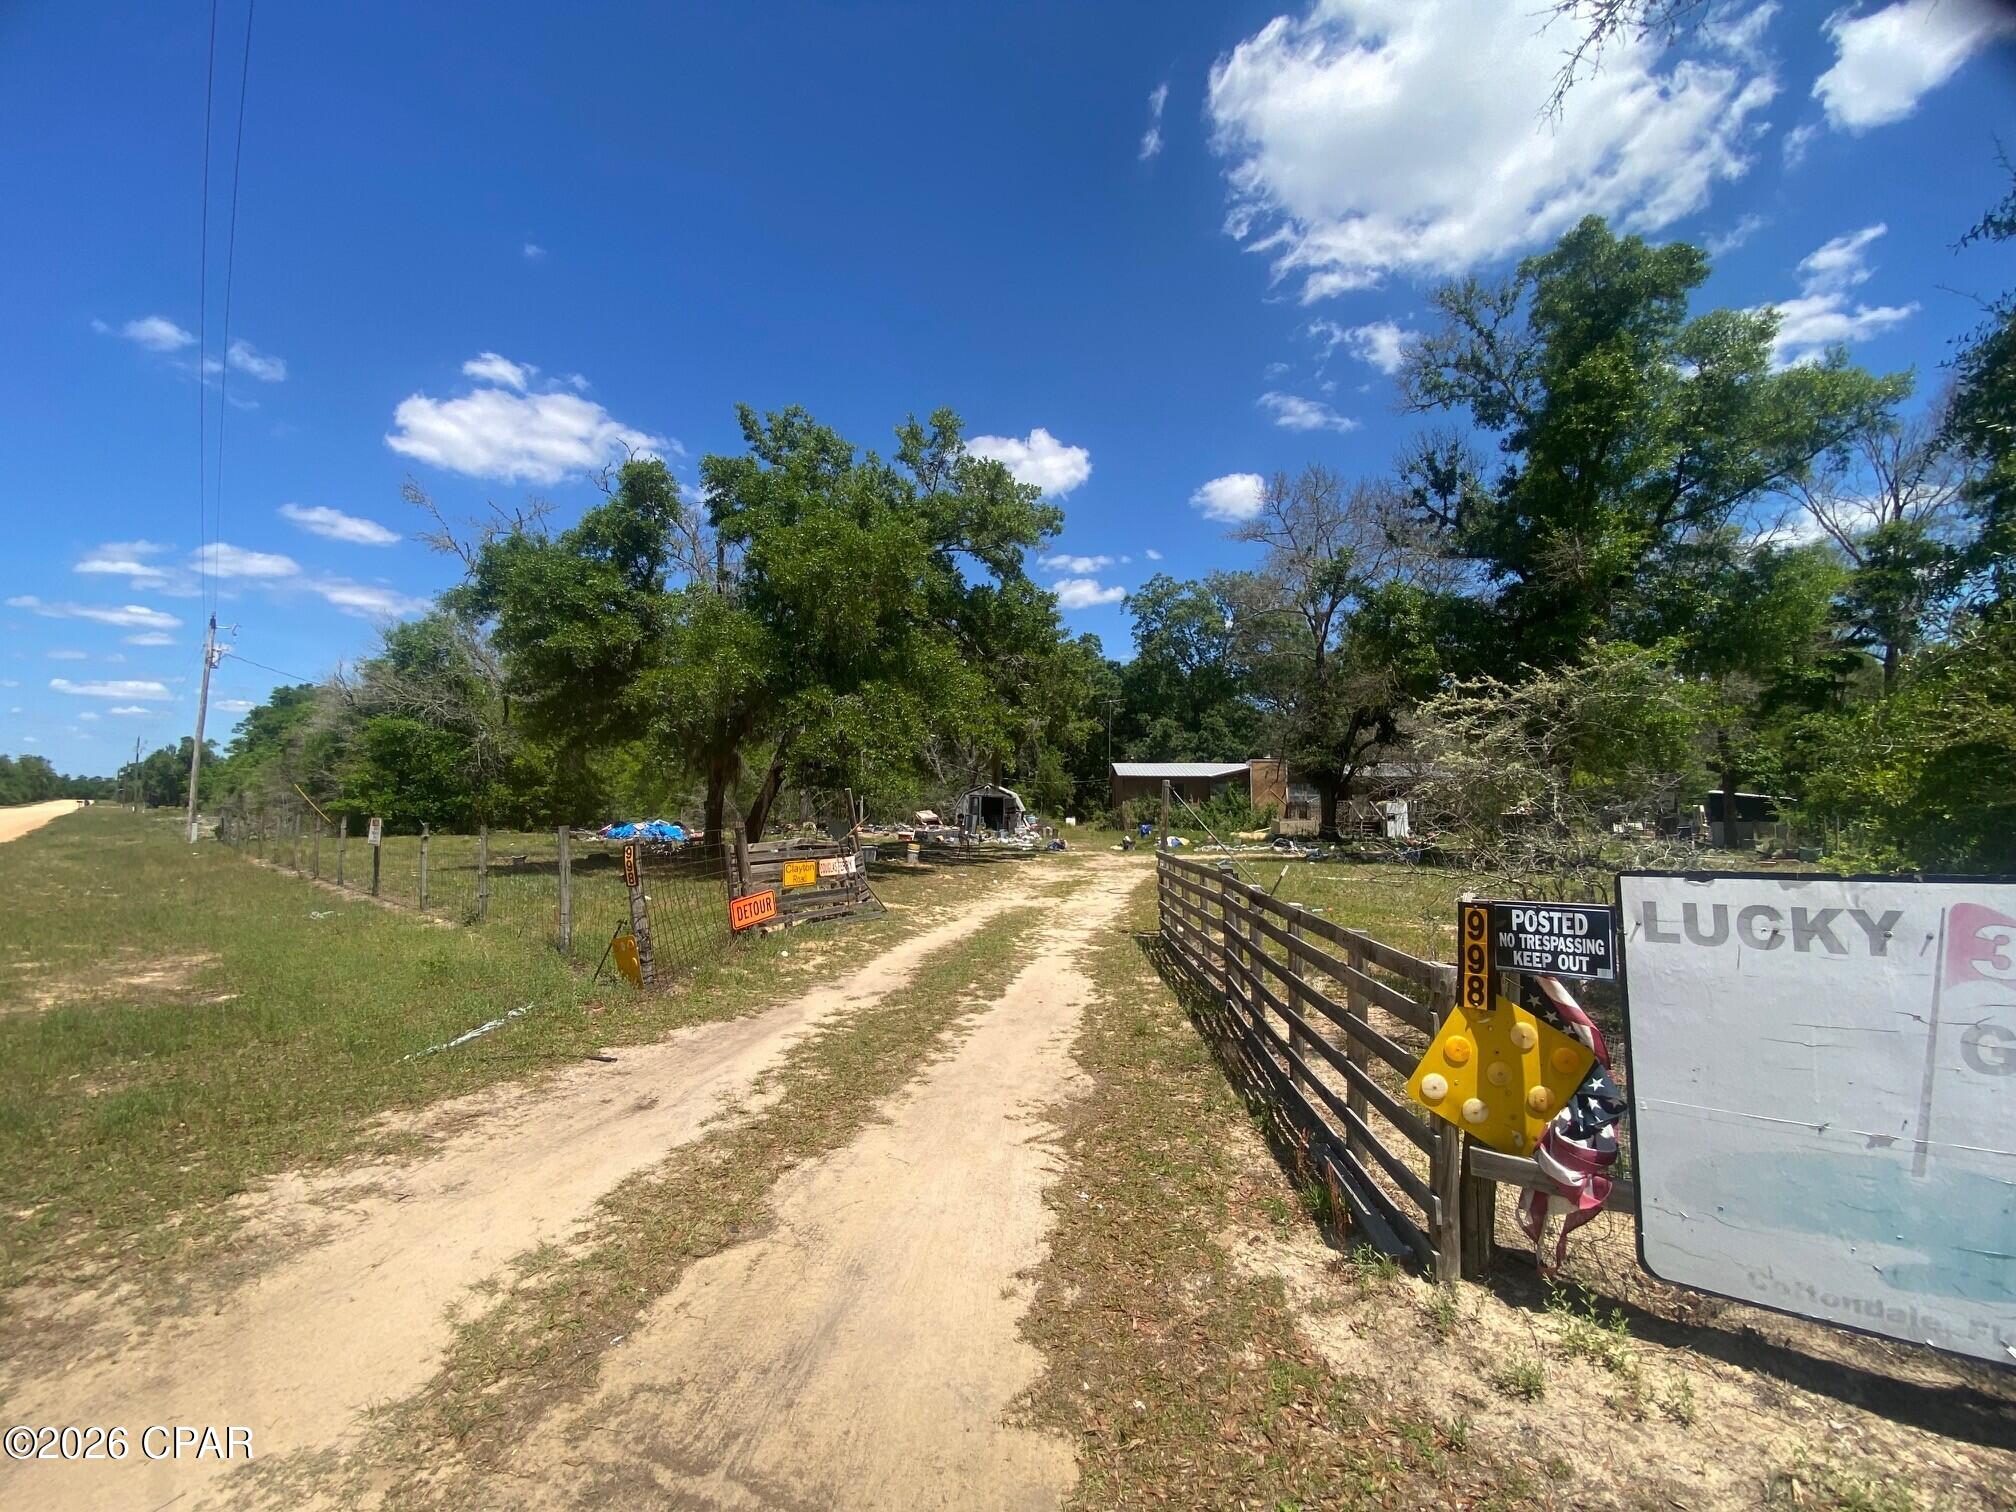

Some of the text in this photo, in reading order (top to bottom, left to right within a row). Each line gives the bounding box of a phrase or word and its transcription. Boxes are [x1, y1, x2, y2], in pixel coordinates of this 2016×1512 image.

[626, 847, 635, 884] 998
[785, 863, 815, 875] Clayton
[793, 874, 807, 884] Road
[736, 897, 772, 921] DETOUR
[1511, 909, 1588, 936] POSTED
[1643, 901, 1904, 957] LUCKY
[1499, 932, 1605, 956] NO TRESPASSING
[1467, 910, 1485, 1006] 998
[1513, 951, 1590, 972] KEEP OUT
